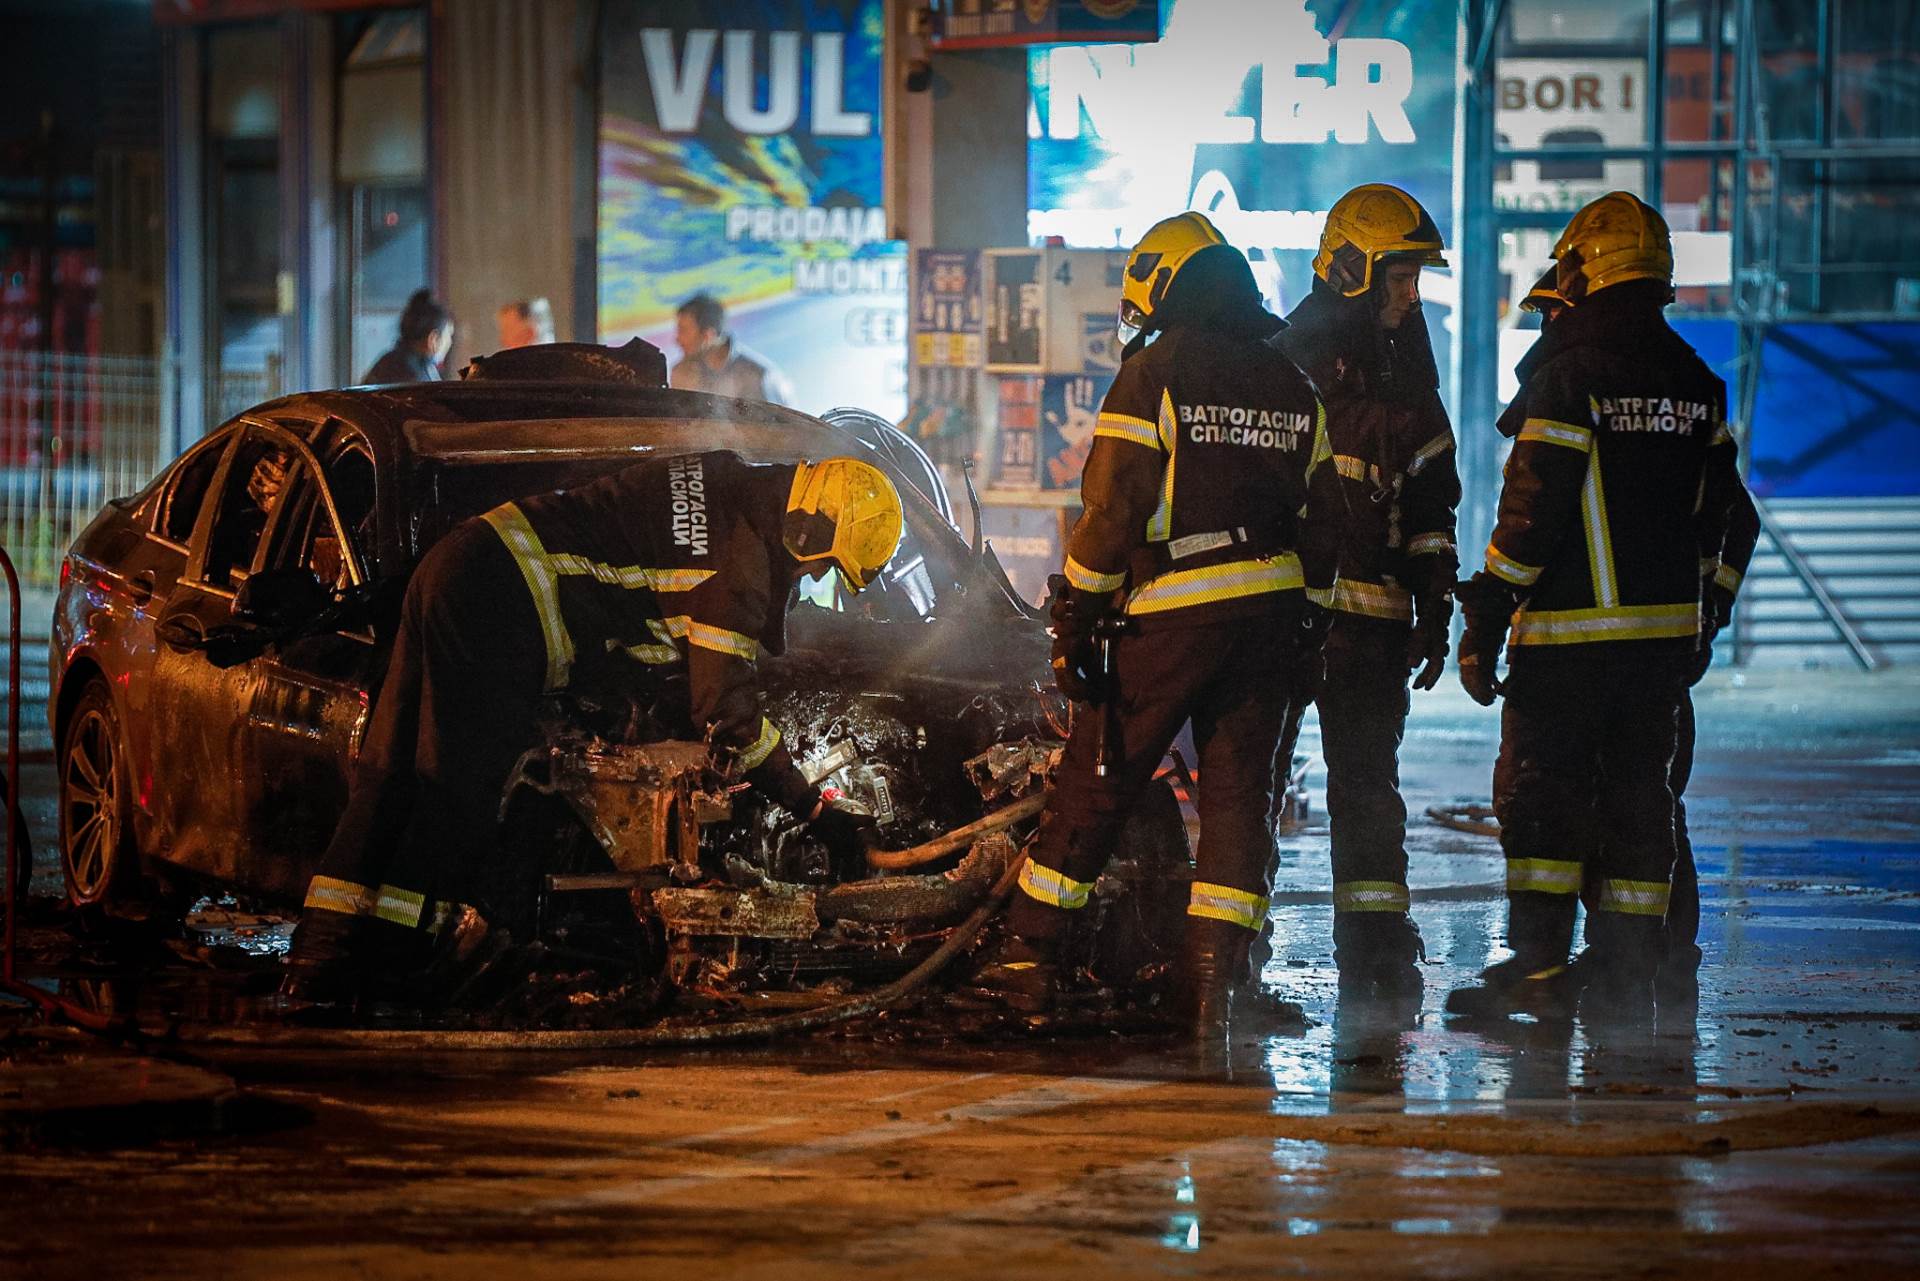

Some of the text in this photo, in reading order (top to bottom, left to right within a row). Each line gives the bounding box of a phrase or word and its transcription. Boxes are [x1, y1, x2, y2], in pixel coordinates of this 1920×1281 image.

[640, 27, 882, 137] VUL
[727, 208, 887, 246] PRODAJA
[795, 258, 908, 291] MONT
[1179, 404, 1310, 433] ВАТРОГАСЦИ
[1190, 425, 1298, 452] СПАСИОЦИ
[685, 456, 708, 556] АТРОГАСЦИ
